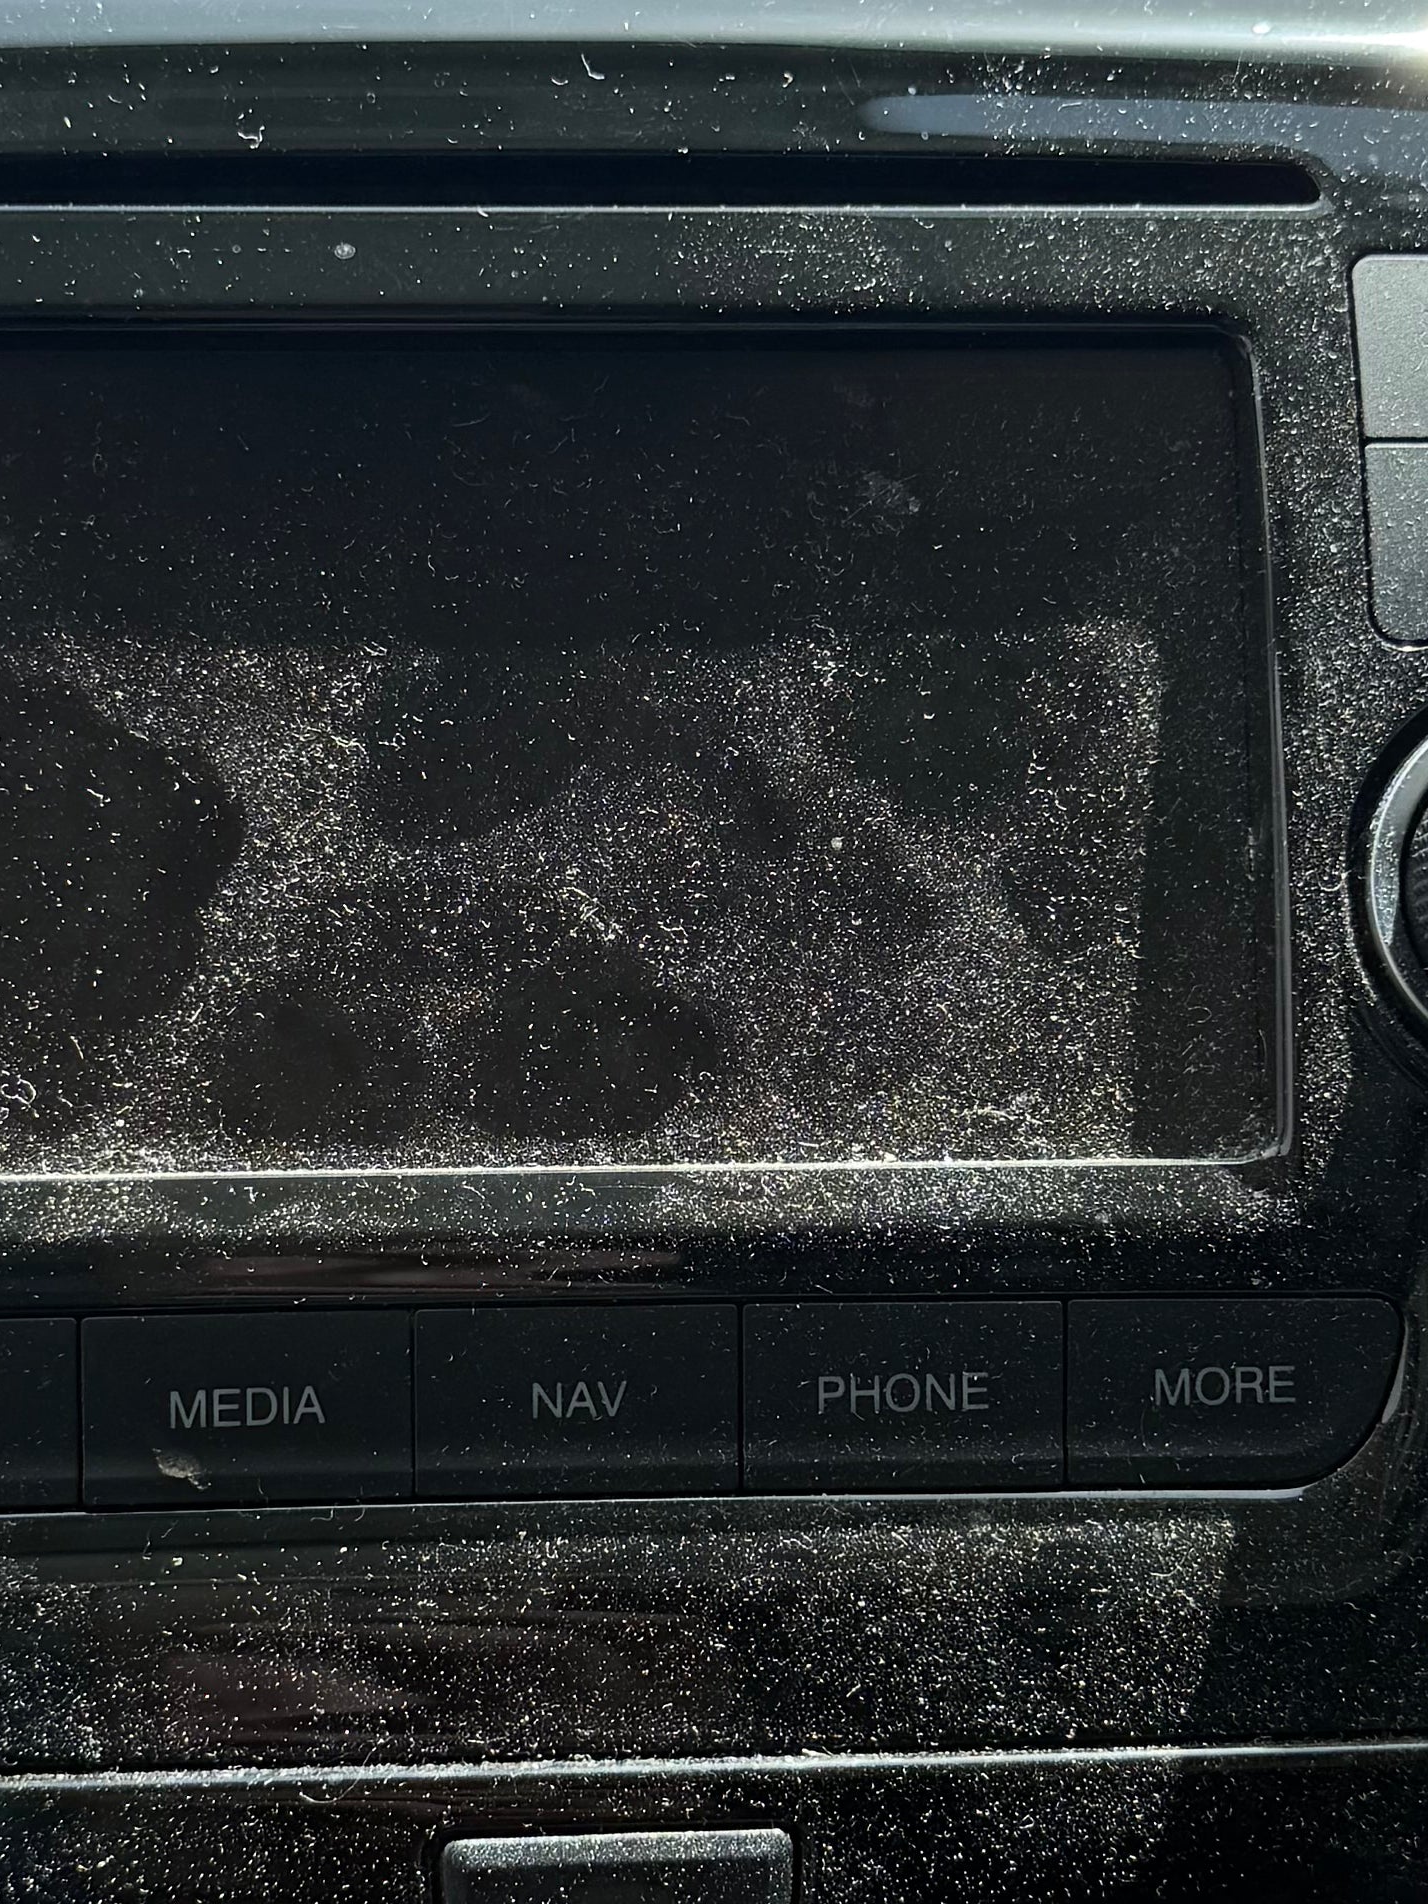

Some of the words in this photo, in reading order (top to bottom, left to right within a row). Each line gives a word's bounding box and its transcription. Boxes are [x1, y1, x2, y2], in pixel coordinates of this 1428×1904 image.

[530, 1379, 629, 1420] NAV
[815, 1370, 991, 1414] PHONE
[1154, 1365, 1297, 1407] MORE
[168, 1385, 327, 1431] MEDIA
